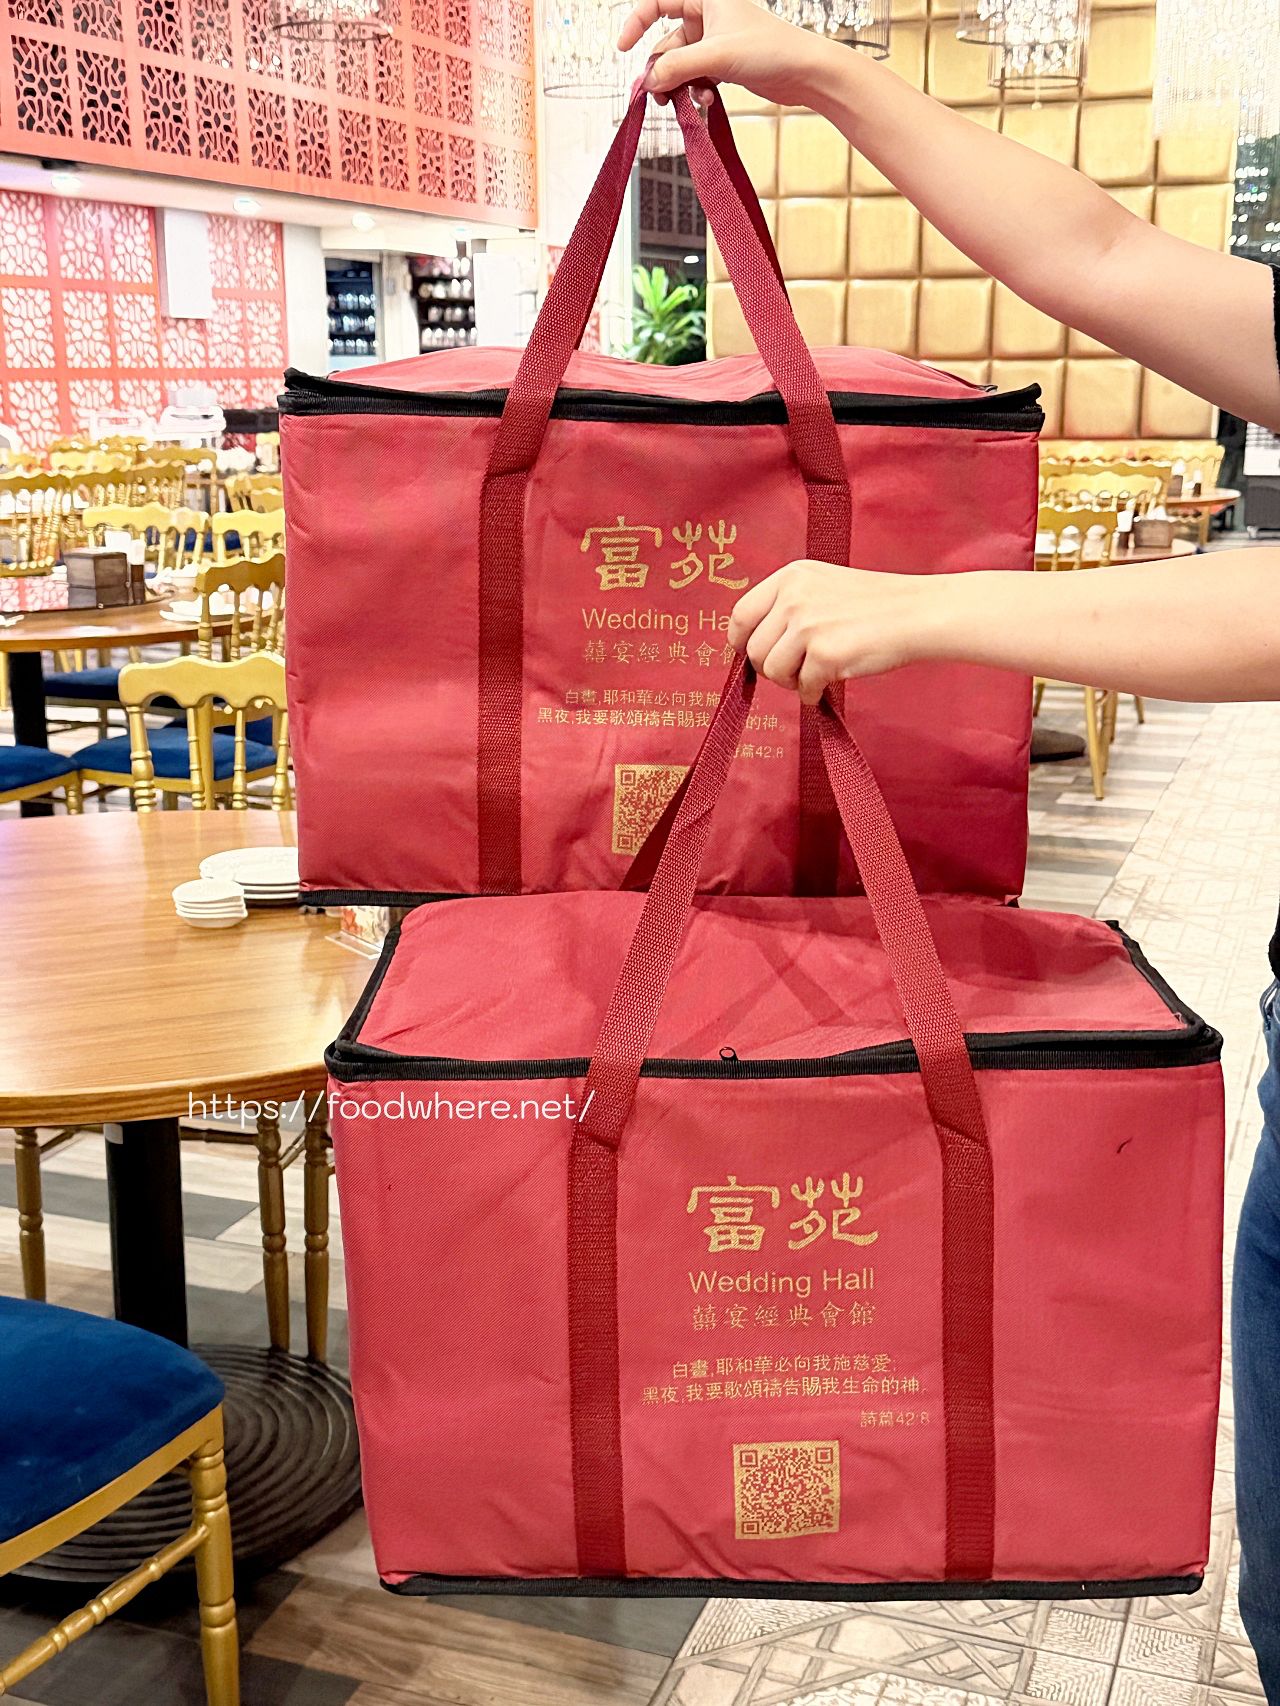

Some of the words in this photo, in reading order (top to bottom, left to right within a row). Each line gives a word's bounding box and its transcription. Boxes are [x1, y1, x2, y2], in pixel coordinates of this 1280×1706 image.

[580, 516, 749, 590] 富苑
[582, 608, 689, 635] Wedding
[699, 609, 731, 631] Ha
[686, 1172, 879, 1253] 富苑
[688, 1270, 811, 1298] Wedding
[823, 1267, 875, 1291] Hall
